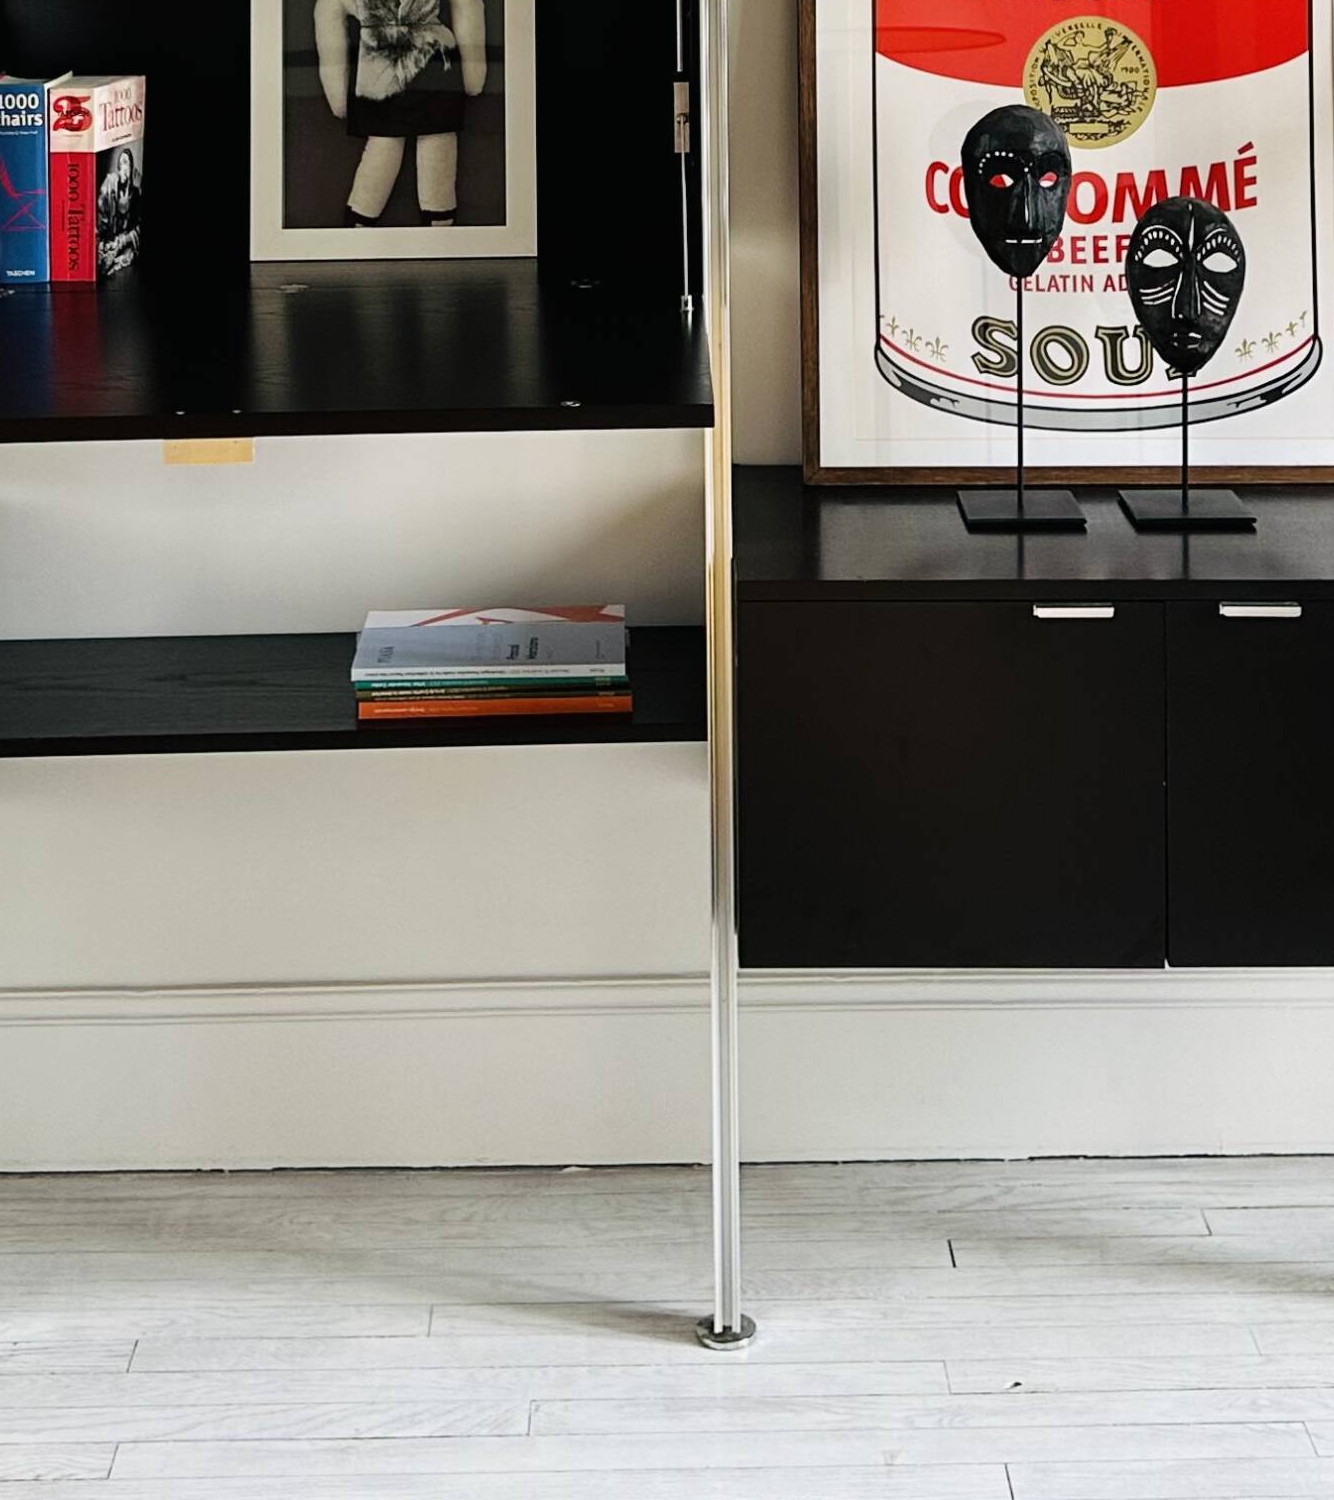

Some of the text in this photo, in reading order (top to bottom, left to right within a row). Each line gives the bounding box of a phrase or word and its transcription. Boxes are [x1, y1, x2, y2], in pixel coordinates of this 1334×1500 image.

[99, 100, 143, 132] Tattoos
[67, 163, 86, 271] 1000 Tattoos
[925, 141, 1257, 224] COOMMÉ
[1008, 274, 1094, 293] GELATIN
[971, 315, 1197, 387] SOU
